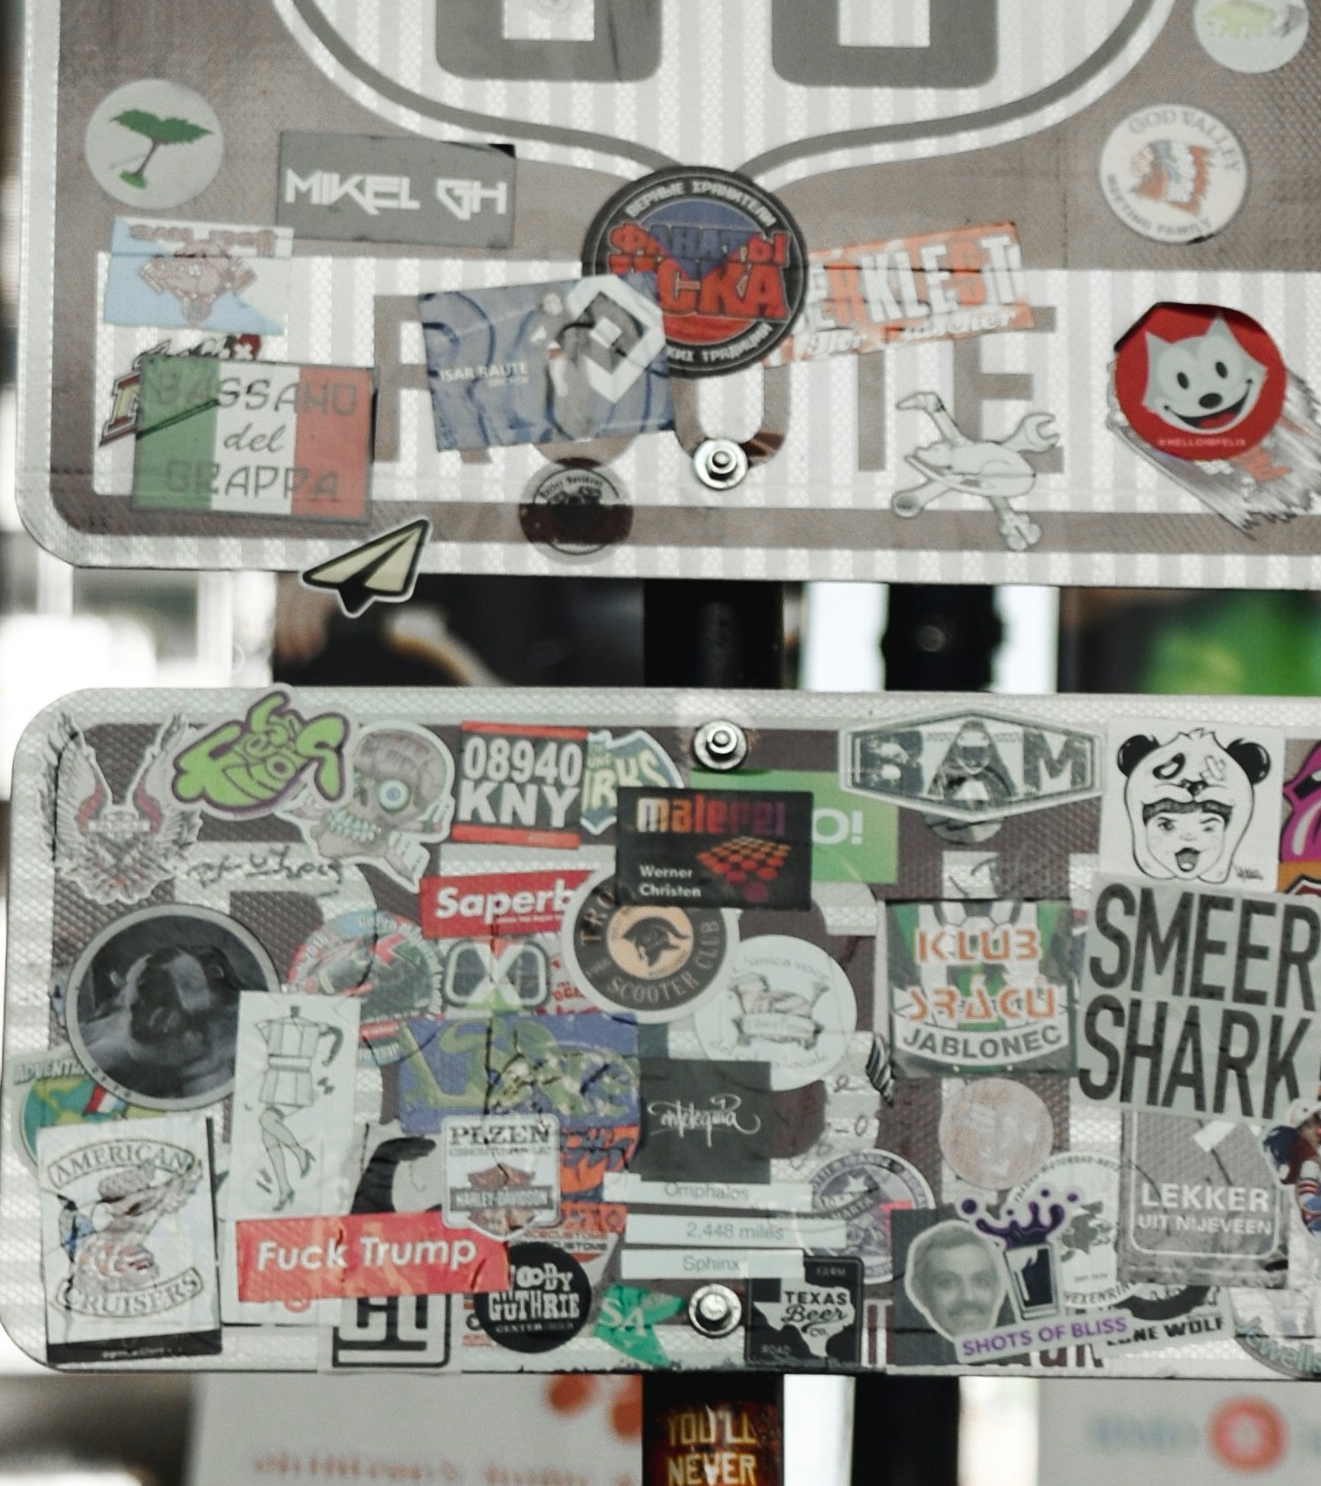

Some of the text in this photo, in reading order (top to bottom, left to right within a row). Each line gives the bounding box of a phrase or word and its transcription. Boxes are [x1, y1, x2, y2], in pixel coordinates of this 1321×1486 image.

[284, 168, 509, 221] MIKEL GH
[155, 370, 358, 417] BASSANO
[222, 422, 287, 453] del
[166, 459, 342, 503] GRAPPA
[463, 735, 583, 787] 08940
[457, 778, 581, 828] KNY
[638, 864, 694, 879] Werner
[638, 883, 702, 898] Christen
[915, 927, 1041, 963] KLUB
[609, 970, 701, 1003] SCOOTER
[901, 1024, 1063, 1060] JABLONEC
[1078, 993, 1314, 1121] SHARK
[57, 1143, 193, 1180] AMERICAN
[664, 1183, 750, 1202] Omphalos
[1141, 1181, 1270, 1214] LEKKER
[686, 1221, 784, 1240] 2,448 miles
[256, 1234, 477, 1273] Fuck Trump
[682, 1255, 741, 1274] Sphinx
[488, 1290, 580, 1322] GUTHRIE
[783, 1290, 848, 1305] TEXAS
[962, 1330, 1033, 1358] SHOTS
[1038, 1325, 1065, 1344] OF
[1070, 1316, 1128, 1339] BLISS
[1162, 1316, 1226, 1339] WOLF
[668, 1410, 757, 1446] YOU'LL
